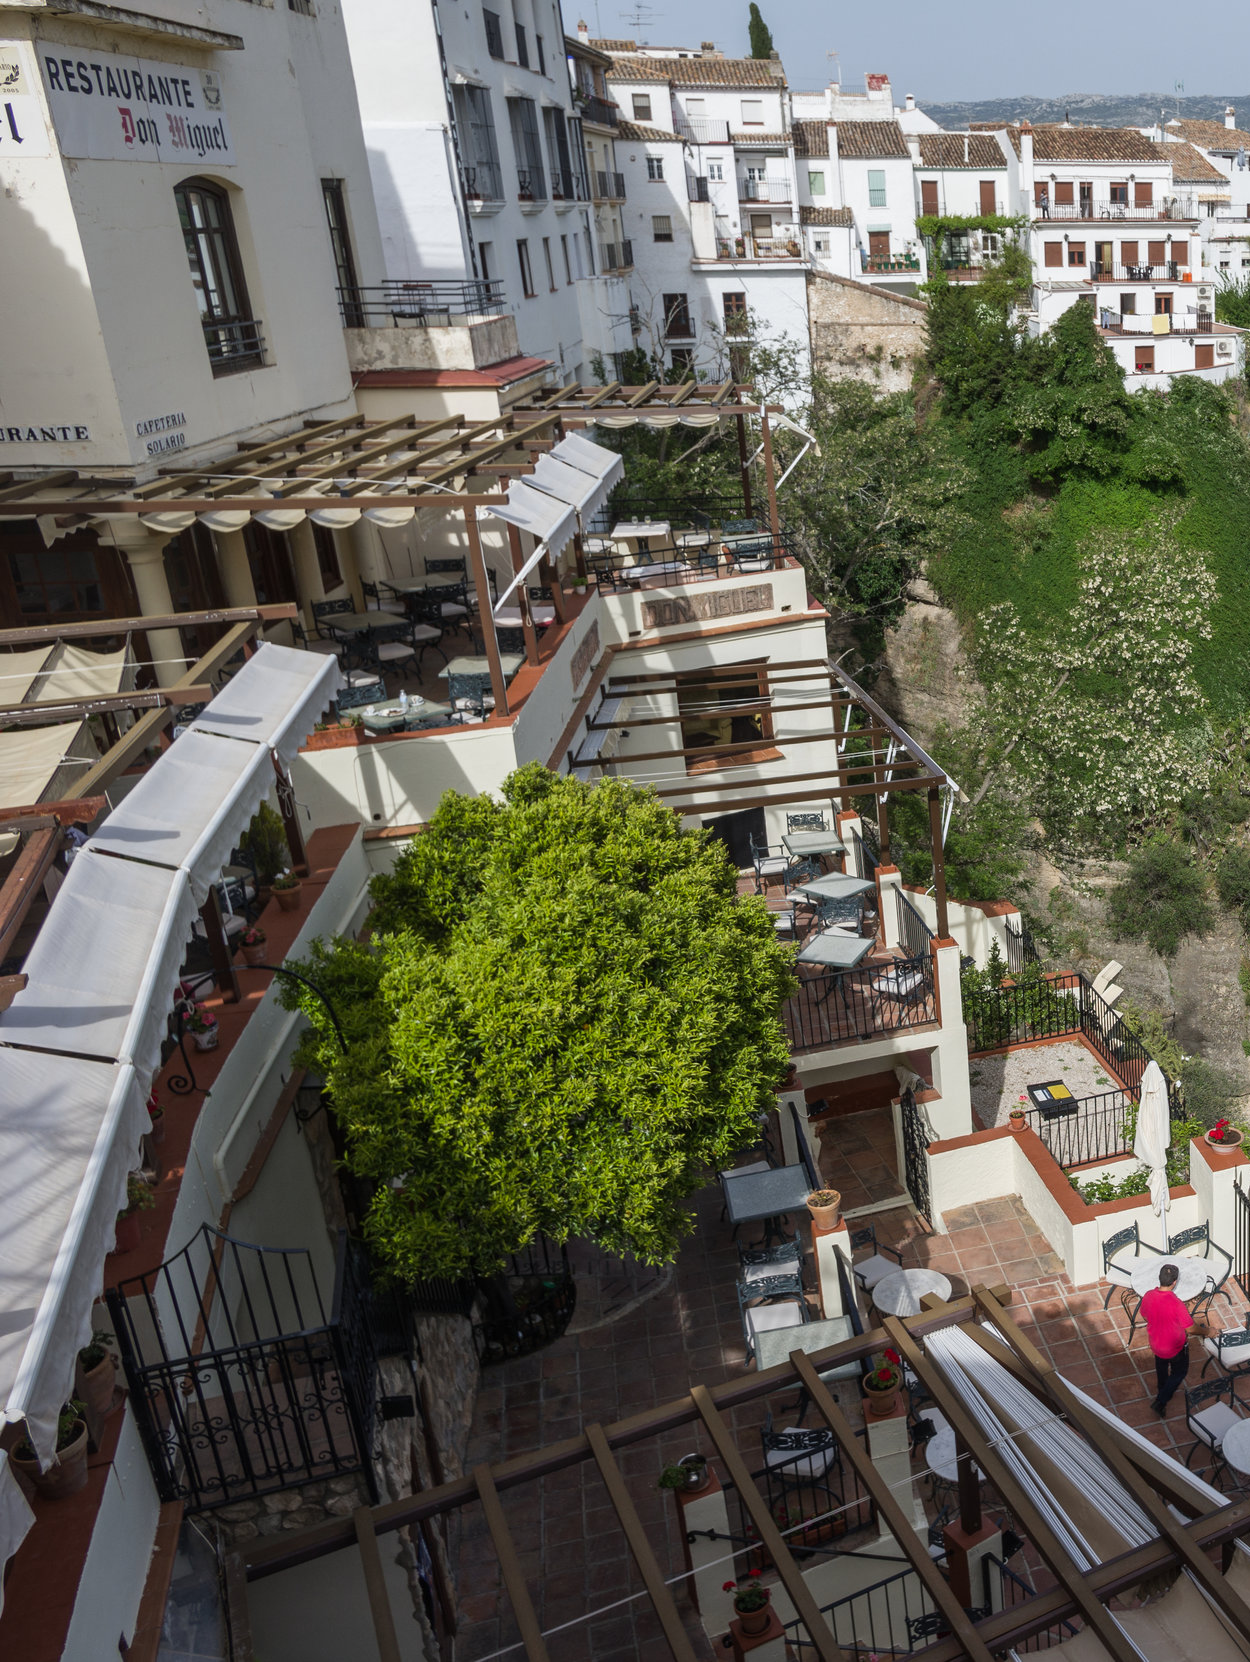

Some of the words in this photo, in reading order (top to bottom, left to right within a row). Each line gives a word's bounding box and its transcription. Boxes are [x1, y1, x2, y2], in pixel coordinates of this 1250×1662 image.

[44, 56, 195, 109] RESTAURANTE
[116, 105, 161, 149] Don
[165, 112, 228, 158] Miguel
[136, 412, 187, 436] CAFETERIA
[146, 432, 186, 456] SOLARIO
